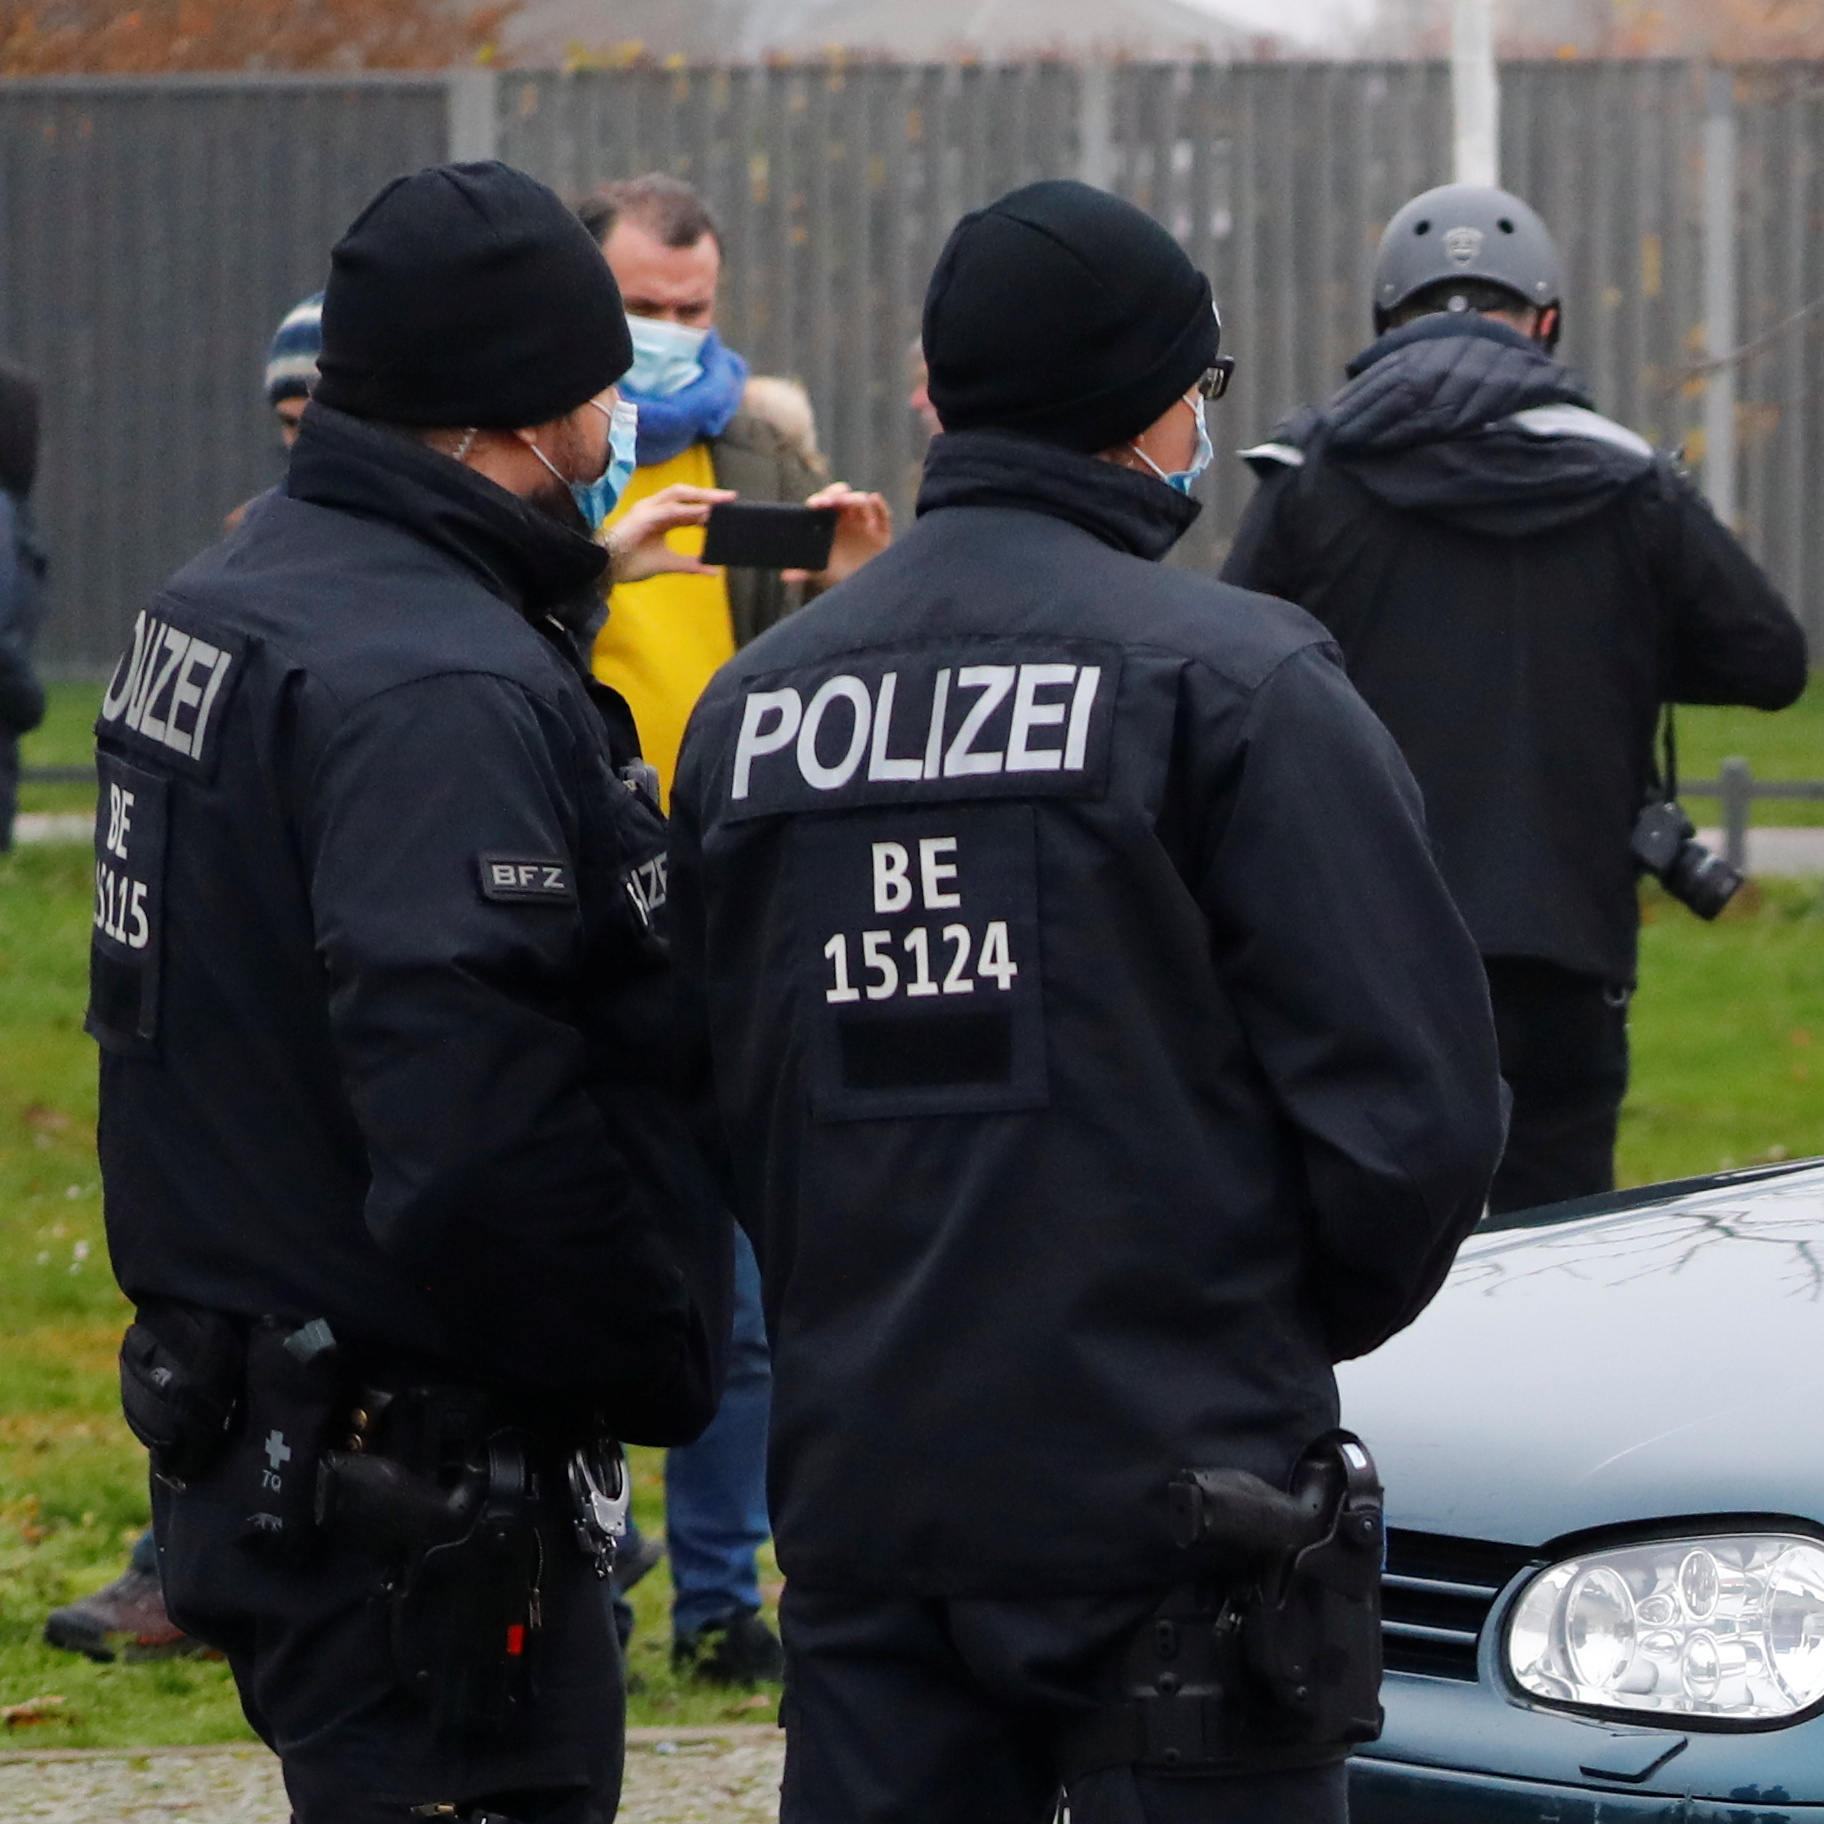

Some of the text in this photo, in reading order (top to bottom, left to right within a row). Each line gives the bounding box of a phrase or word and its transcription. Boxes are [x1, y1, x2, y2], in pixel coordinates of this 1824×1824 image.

[102, 609, 233, 762] OLIZEI
[731, 663, 1102, 801] POLIZEI
[106, 782, 136, 860] BE
[94, 861, 150, 950] 5115
[491, 863, 566, 890] BFZ
[871, 836, 961, 914] BE
[823, 920, 1019, 1004] 15124
[260, 1469, 282, 1494] TQ
